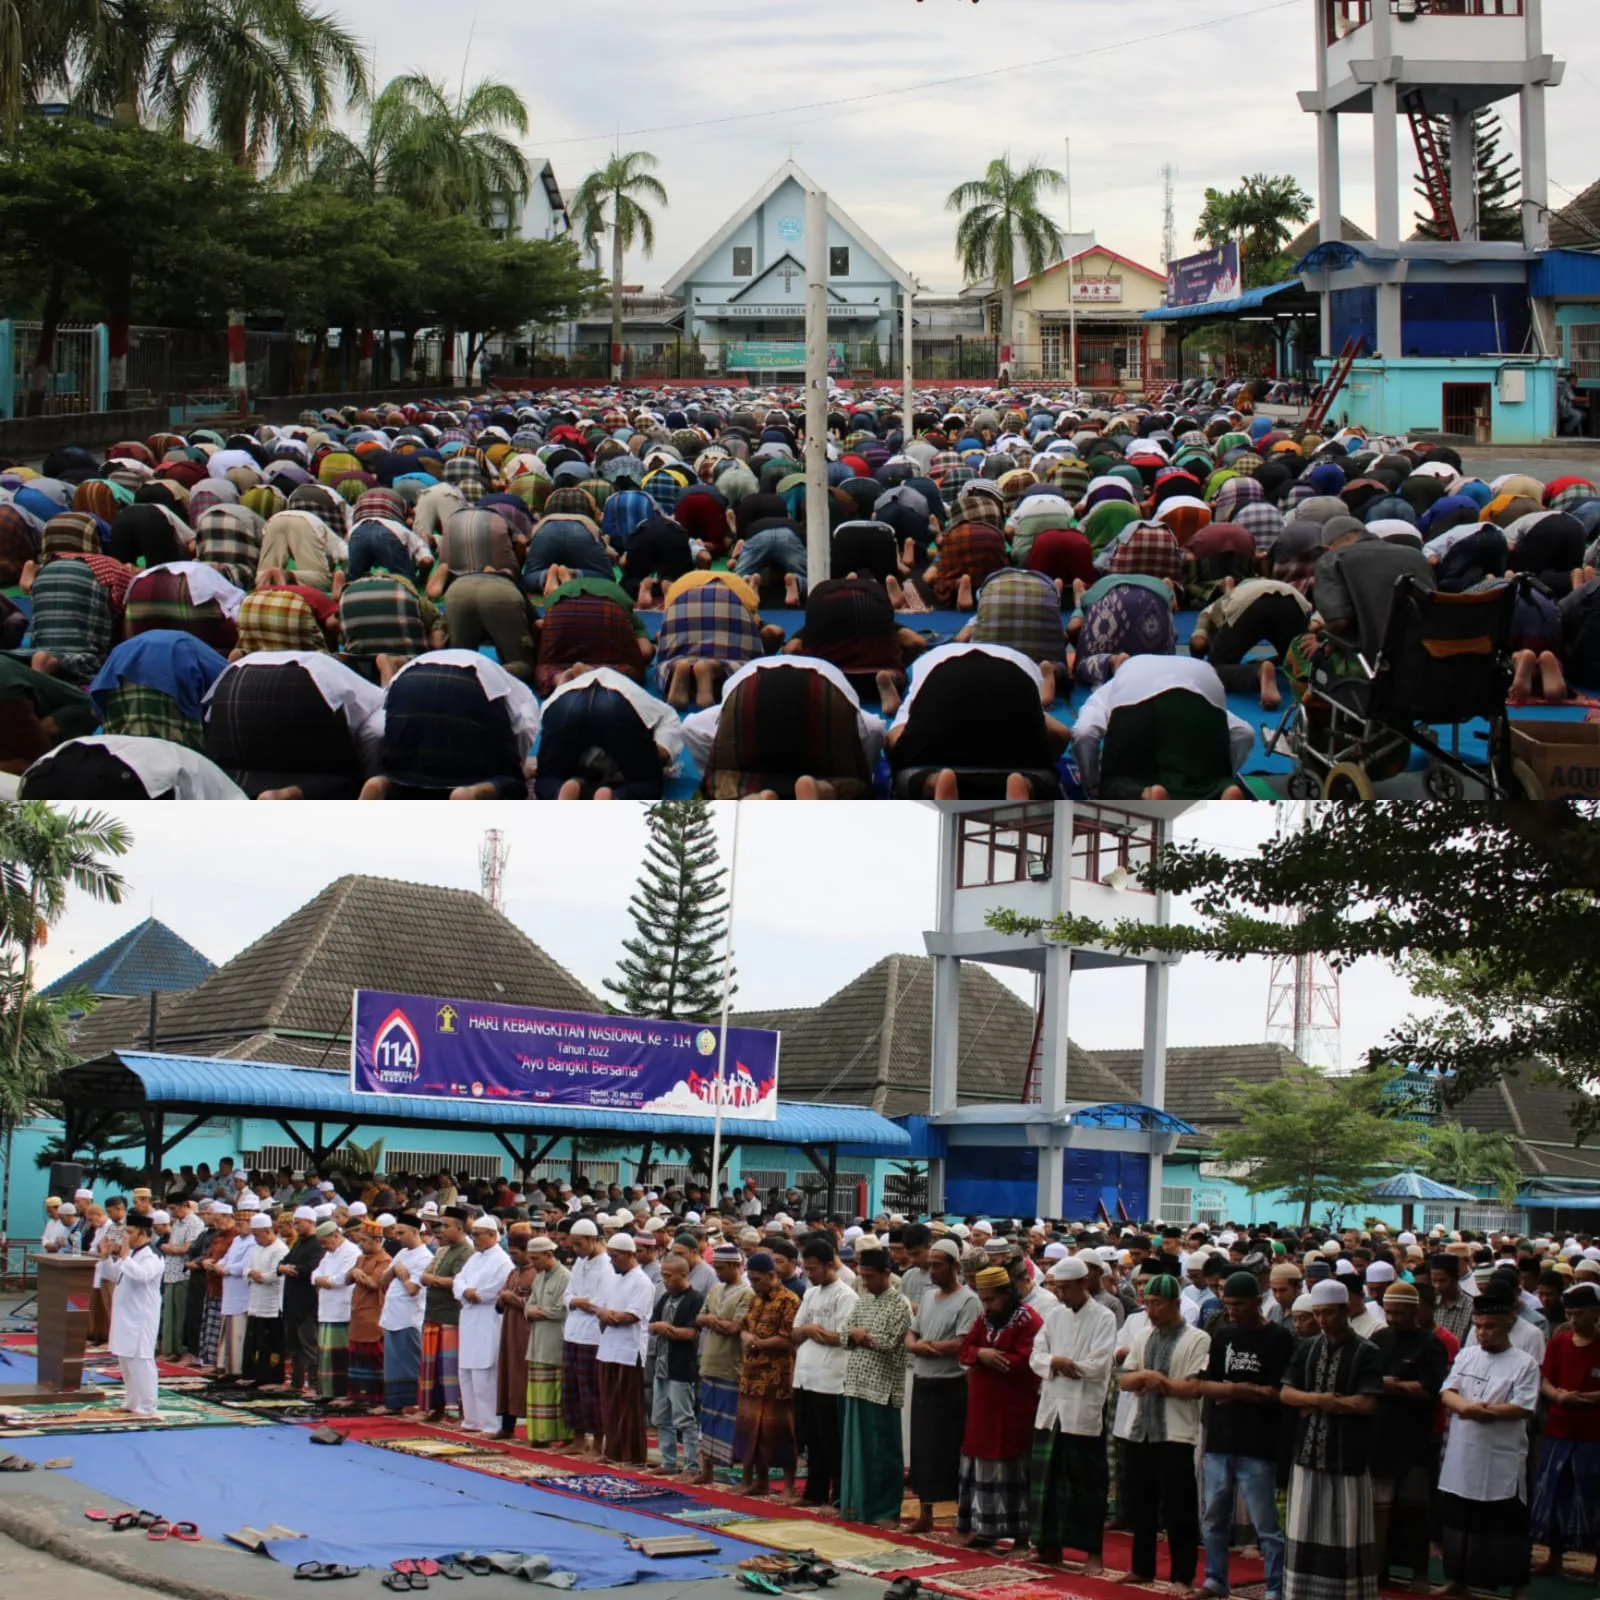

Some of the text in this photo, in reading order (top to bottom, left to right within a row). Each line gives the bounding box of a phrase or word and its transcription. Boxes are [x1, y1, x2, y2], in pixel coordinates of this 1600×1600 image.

[468, 1013, 499, 1031] HARI
[503, 1016, 585, 1039] KEBANGKITAN
[588, 1025, 645, 1045] NASIONAL
[648, 1031, 661, 1045] Ke
[672, 1033, 691, 1048] 114
[380, 1040, 413, 1068] 114
[556, 1041, 609, 1057] Tahun 2022
[547, 1057, 588, 1076] Bangkit
